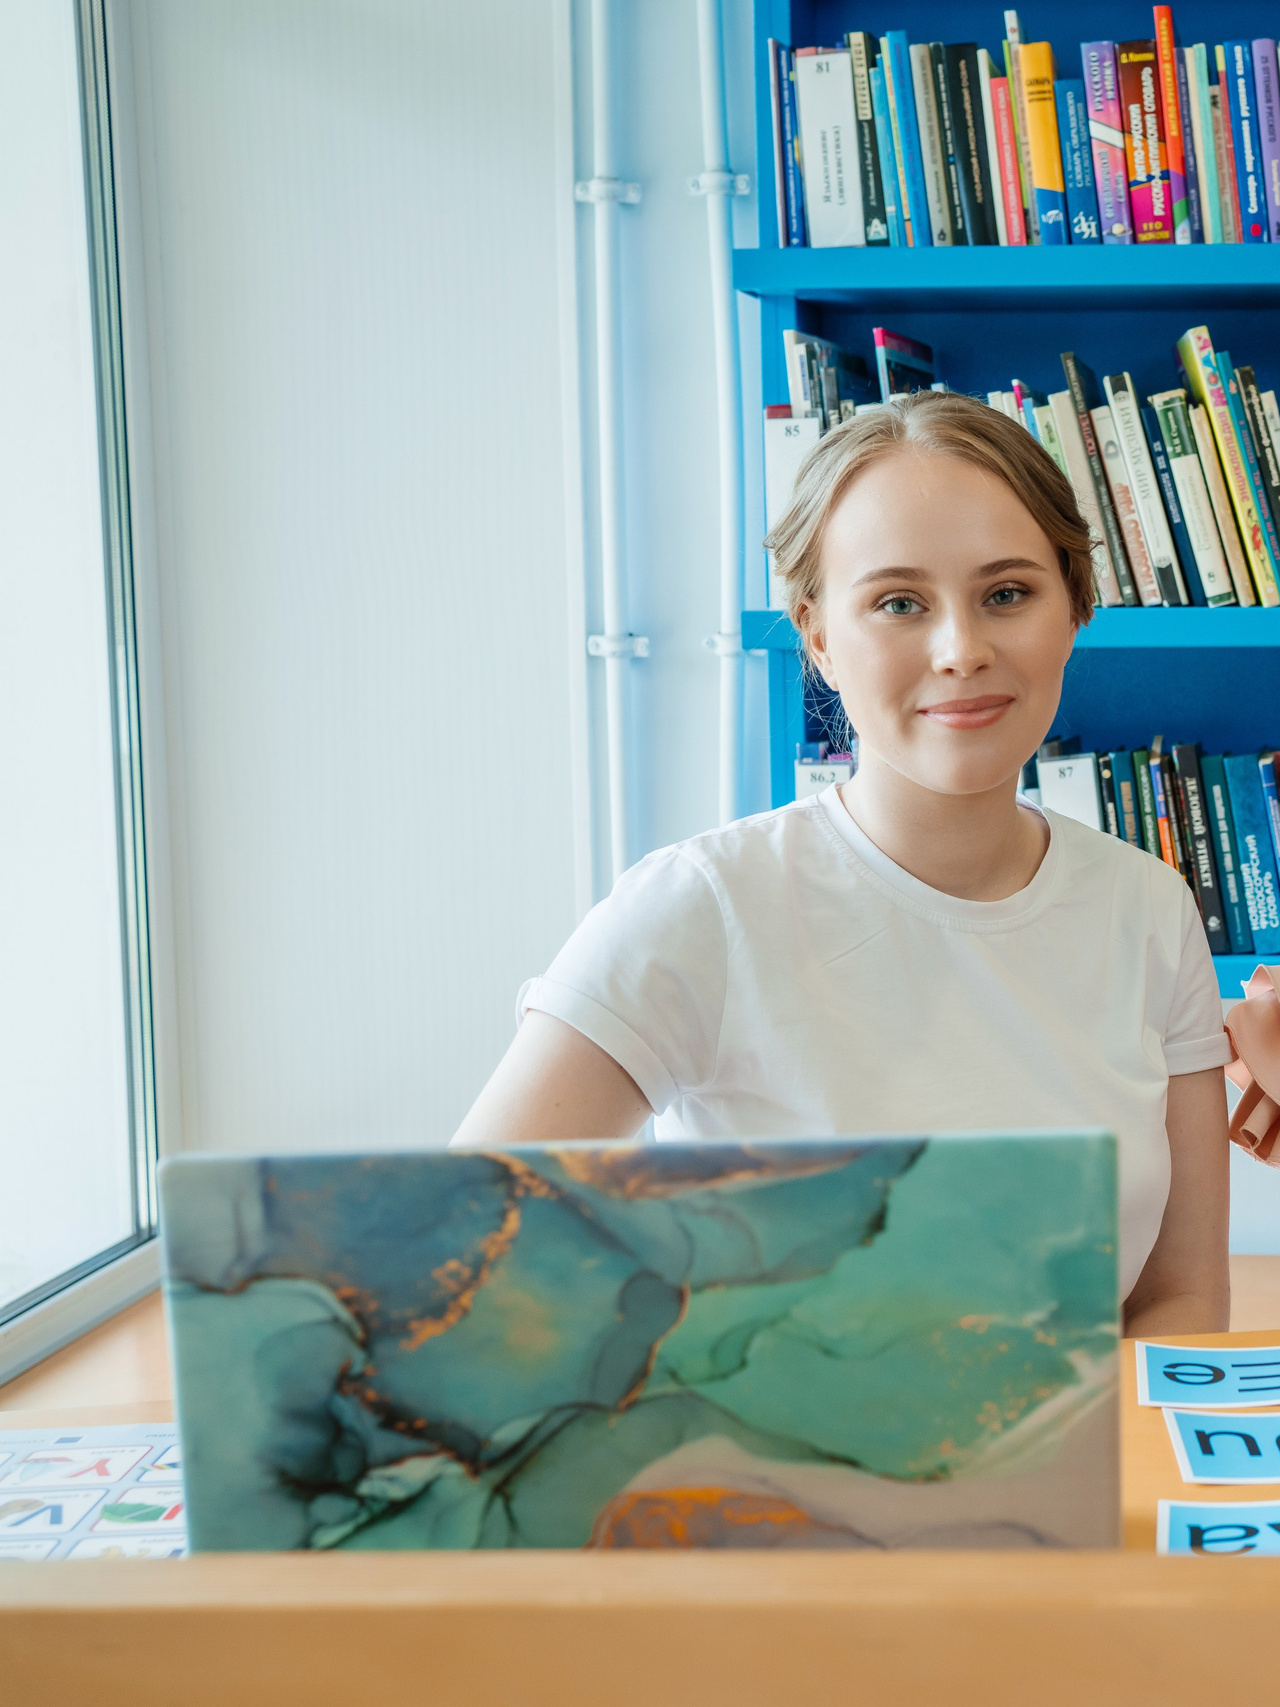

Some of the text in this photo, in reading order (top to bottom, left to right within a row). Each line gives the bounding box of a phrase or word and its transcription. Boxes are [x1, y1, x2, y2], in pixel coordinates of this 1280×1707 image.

[815, 62, 830, 74] 81
[1088, 51, 1104, 110] РУССКОГО
[1103, 60, 1116, 100] ЯЗЫКА
[1159, 17, 1179, 136] АНГЛО-РУССКИЙ СЛОВАРЬ
[1233, 45, 1243, 75] языка
[1142, 67, 1156, 112] СЛОВАРЬ
[1236, 78, 1250, 117] русского
[1128, 103, 1147, 182] АНГЛО-РУССКИЙ
[1144, 113, 1165, 216] РУССКО-АНГЛИЙСКИЙ
[1246, 175, 1258, 214] Словарь
[785, 425, 800, 437] 85
[1079, 413, 1097, 456] ПОРТРЕТ
[1196, 334, 1249, 503] ЭНЦИКЛОПЕДИЯ МОДЫ
[1120, 406, 1153, 500] МИР МУЗЫКИ
[1115, 482, 1136, 515] МИР
[1252, 470, 1261, 486] Так
[1124, 518, 1153, 586] ПОЗНАЮ
[810, 772, 836, 783] 86.2
[1058, 766, 1074, 778] 87
[1184, 776, 1214, 888] ДЕЛОВОЙ ЭТИКЕТ
[1240, 863, 1260, 930] НОВЕЙШИЙ
[1245, 835, 1268, 929] ФИЛОСОФСКИЙ
[1264, 871, 1280, 928] СЛОВАРЬ
